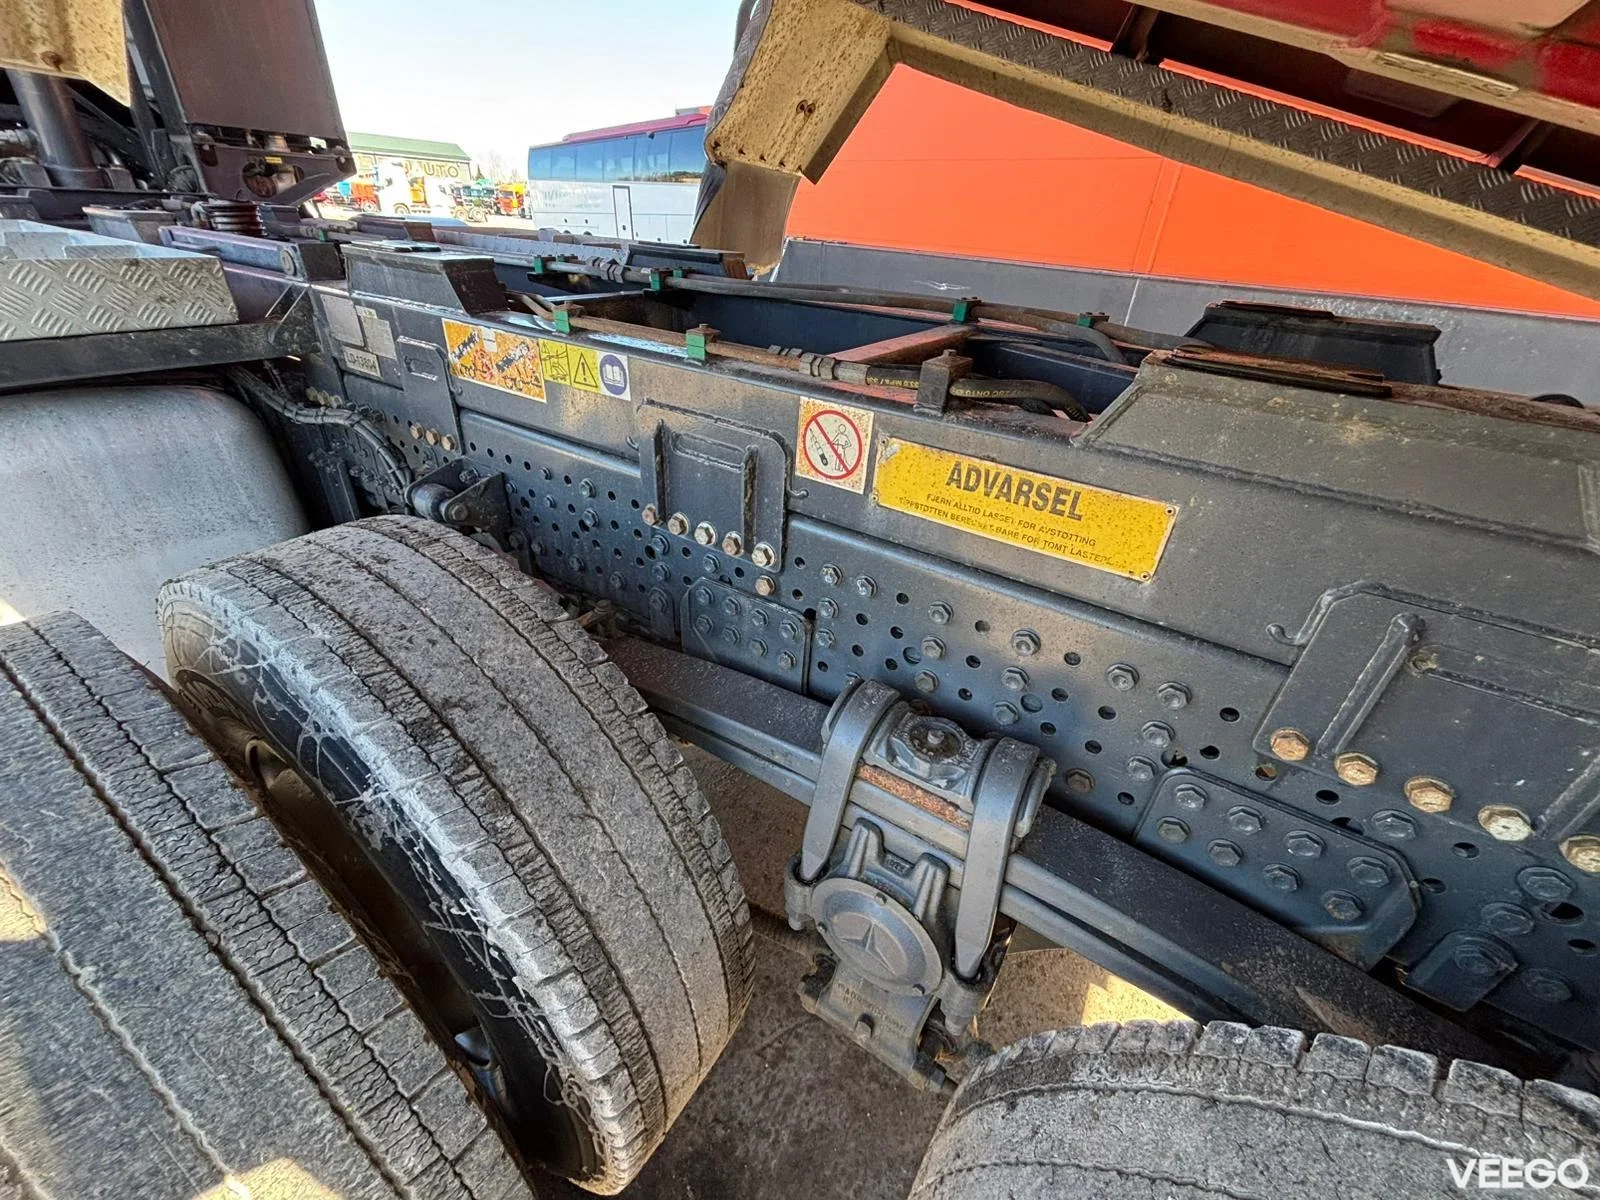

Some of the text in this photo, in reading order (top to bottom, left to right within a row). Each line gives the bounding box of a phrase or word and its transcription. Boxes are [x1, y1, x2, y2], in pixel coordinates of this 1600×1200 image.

[945, 460, 1083, 521] ADVARSEL
[927, 493, 952, 507] FJERN
[953, 501, 981, 515] ALLTID
[1043, 539, 1068, 554] TOMT
